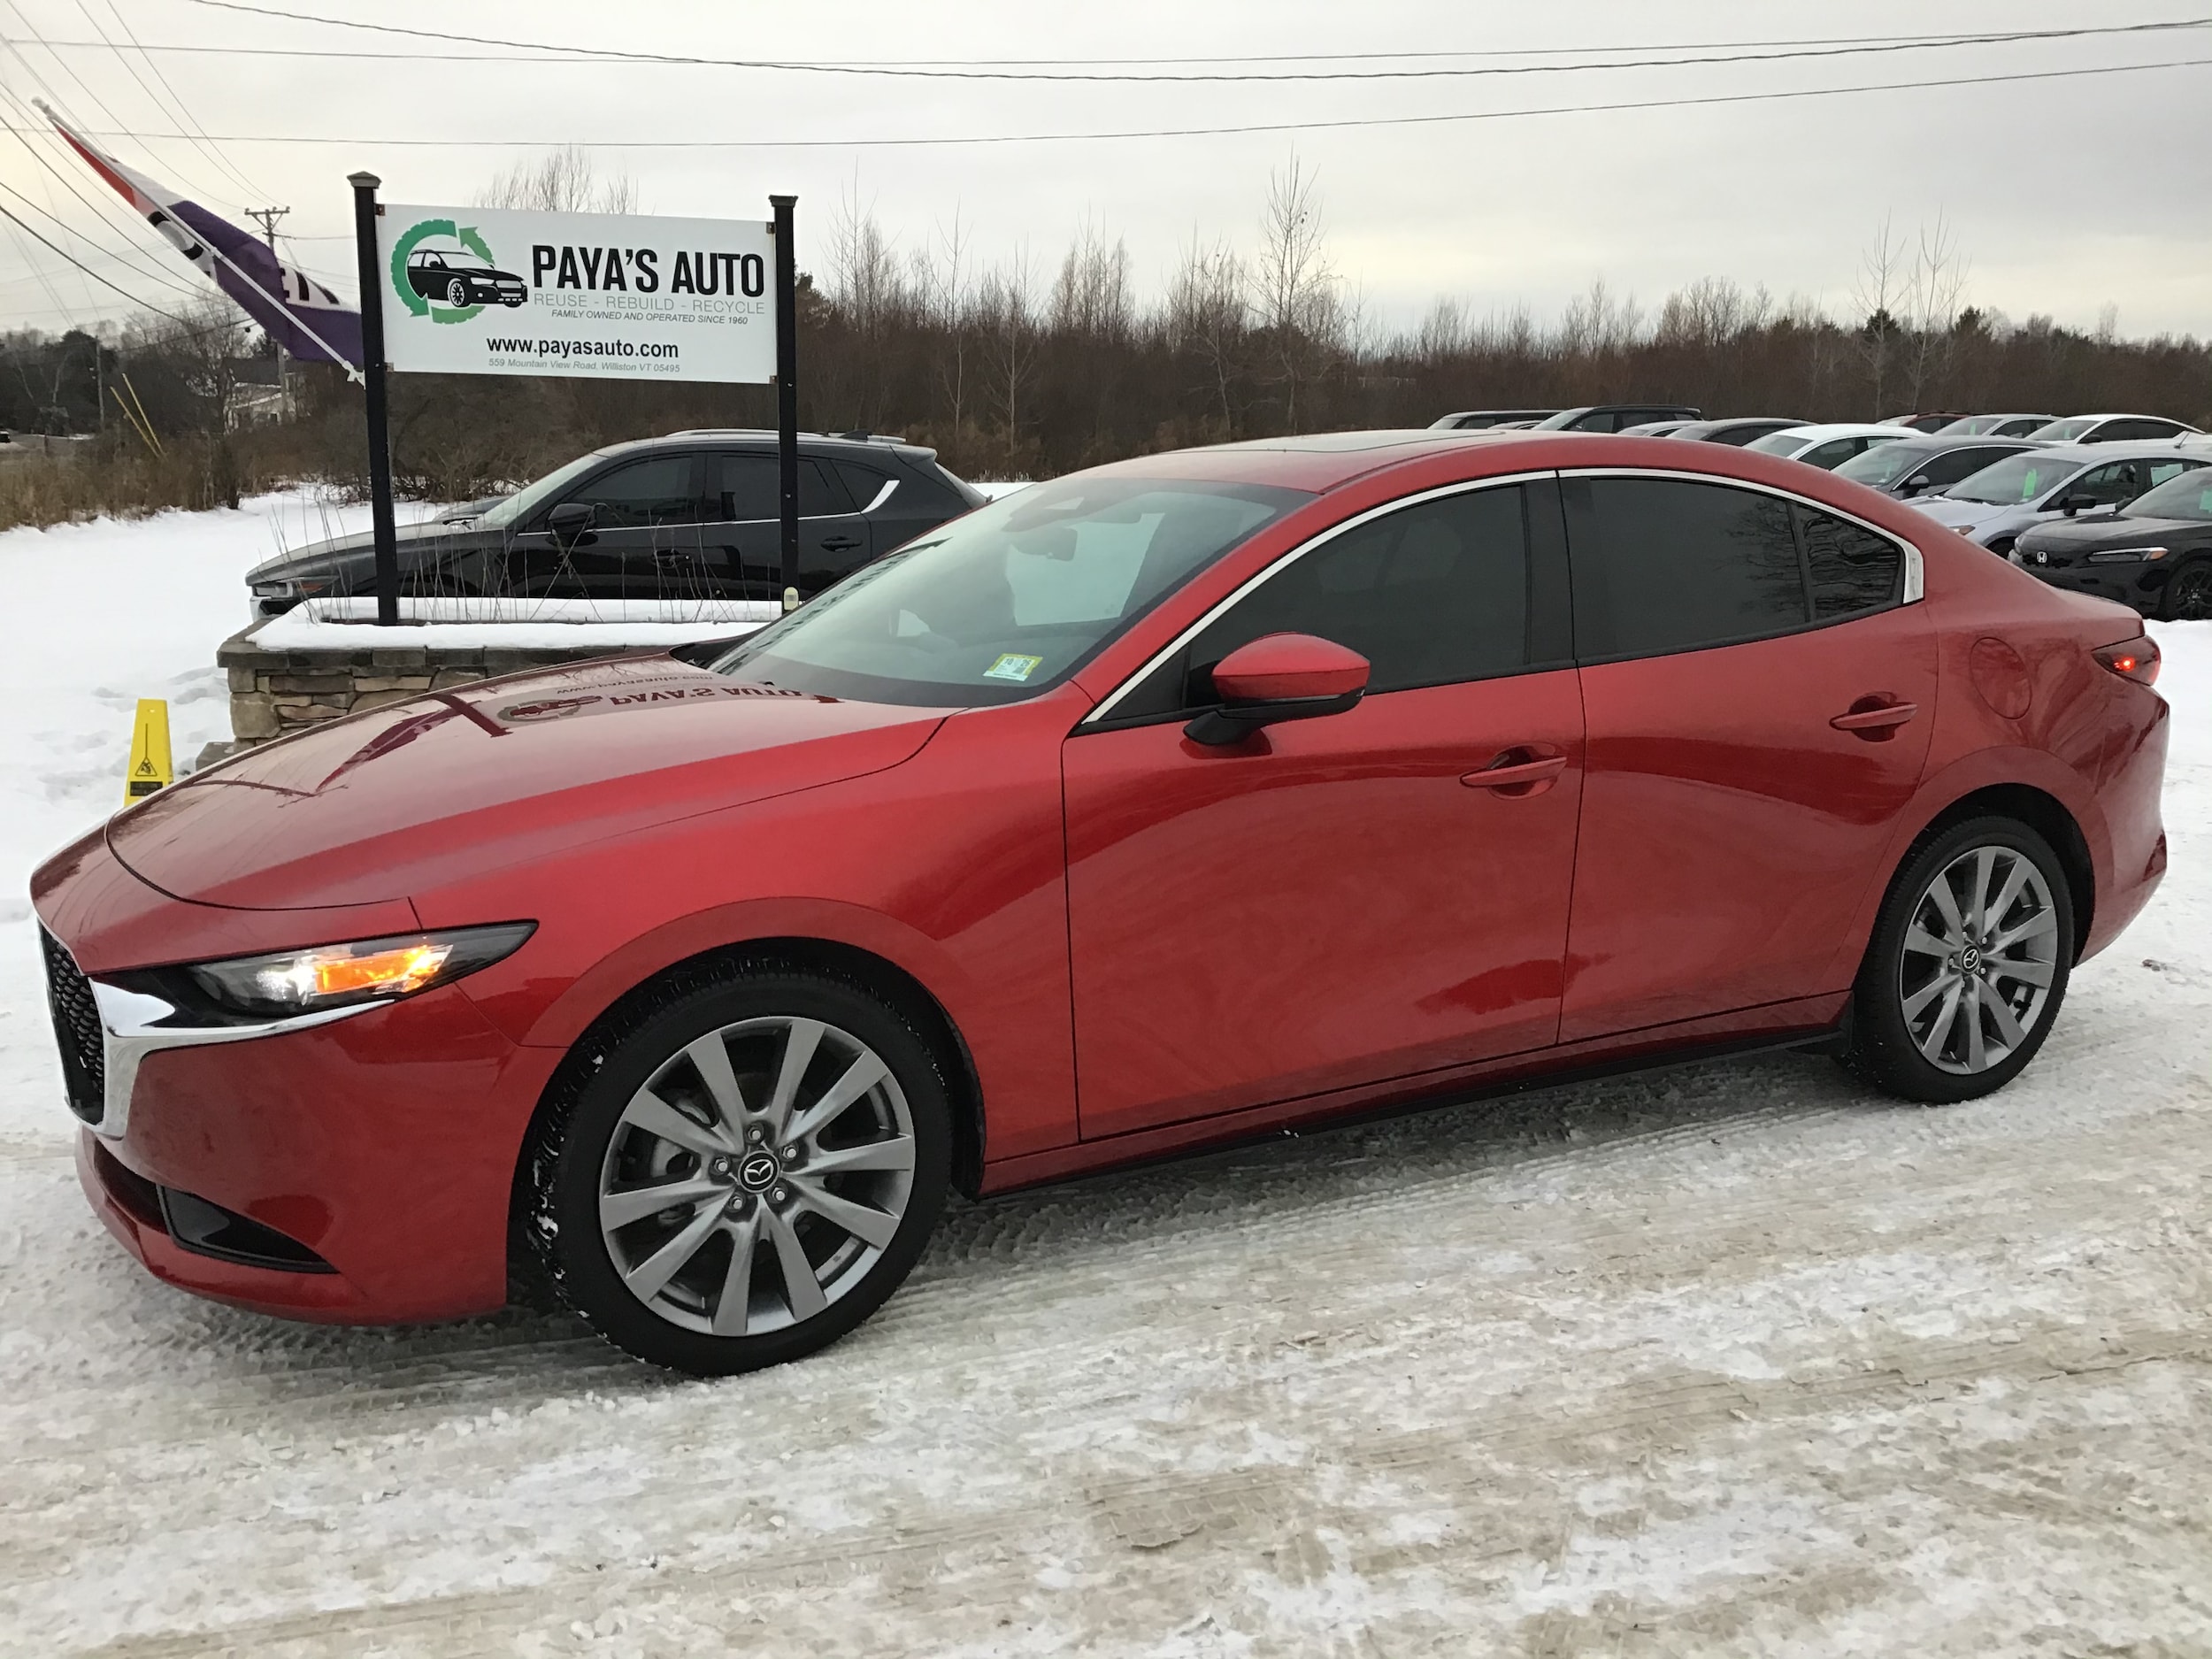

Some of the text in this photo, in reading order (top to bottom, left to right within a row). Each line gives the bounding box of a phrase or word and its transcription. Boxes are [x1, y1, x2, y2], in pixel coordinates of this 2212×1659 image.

[532, 244, 764, 297] PAYA'S AUTO
[534, 293, 588, 307] REUSE
[606, 296, 674, 311] REBUILD
[693, 299, 765, 314] RECYCLE
[551, 309, 585, 319] FAMILY
[586, 311, 622, 319] OWNED
[645, 312, 695, 323] OPERATED
[697, 315, 726, 324] SINCE
[728, 316, 749, 325] 1960
[486, 337, 680, 359] www.payasauto.com
[488, 357, 505, 367] 559
[507, 358, 548, 369] Mountain
[549, 359, 572, 370] View
[601, 362, 637, 372] Williston
[638, 363, 652, 372] VT
[653, 364, 680, 373] 05495
